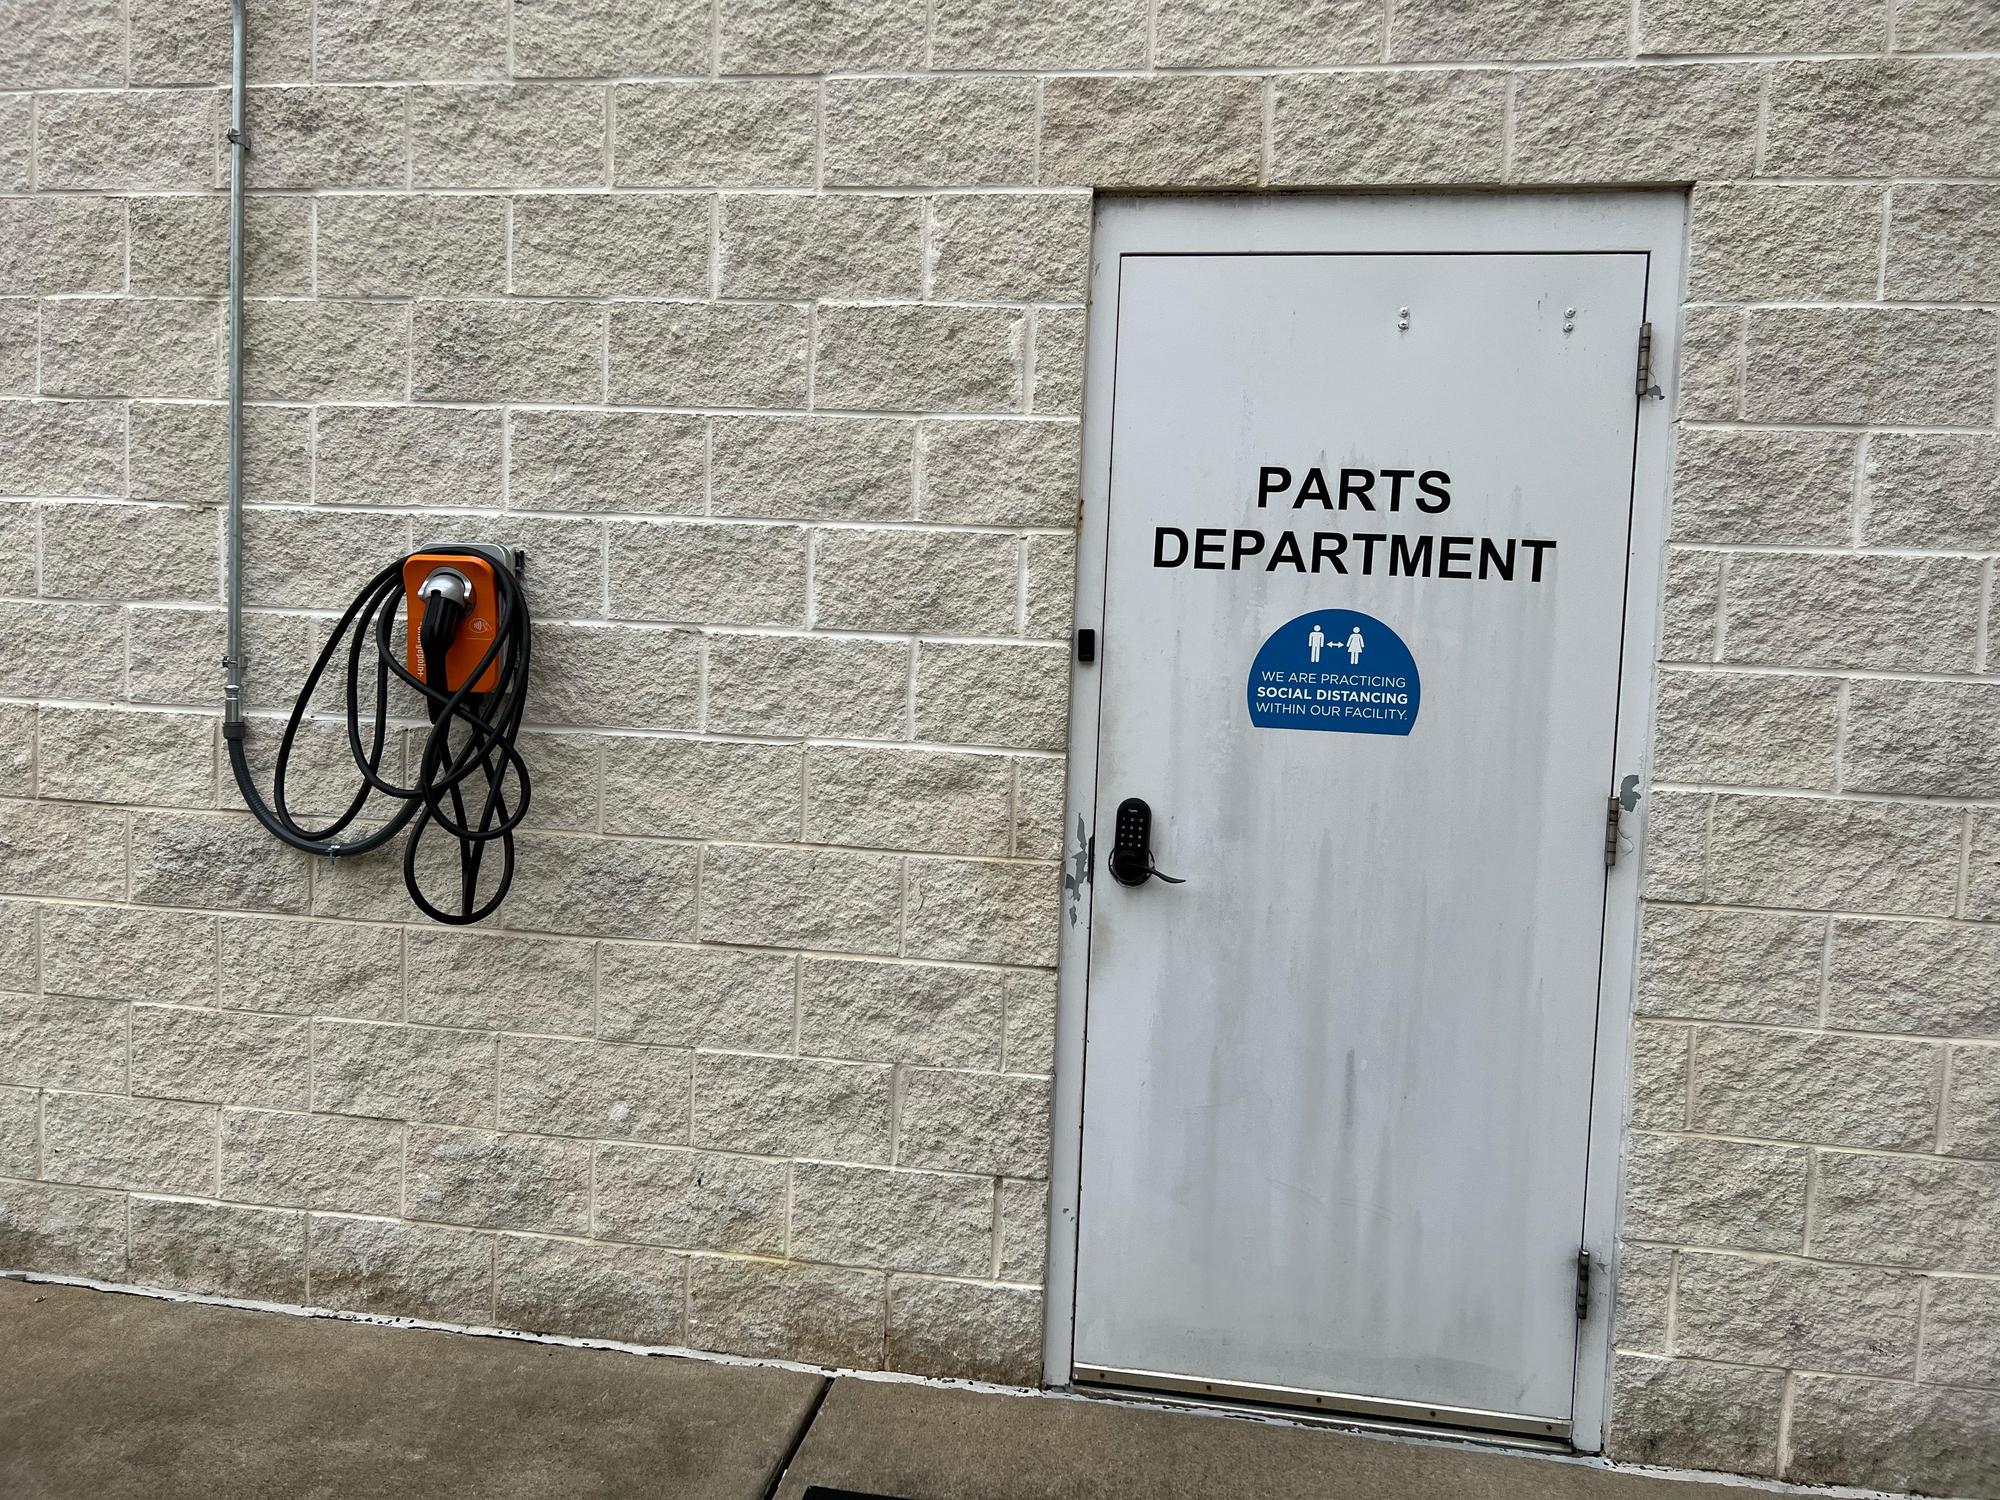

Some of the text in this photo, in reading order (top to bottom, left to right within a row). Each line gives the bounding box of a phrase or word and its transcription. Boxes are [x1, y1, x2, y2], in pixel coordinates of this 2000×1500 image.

[1257, 466, 1452, 514] PARTS
[1153, 526, 1557, 583] DEPARTMENT
[1261, 670, 1406, 688] WE ARE PRACTICING
[1257, 686, 1408, 705] SOCIAL DISTANCING
[1256, 702, 1407, 721] WITHIN OUR FACILITY.
